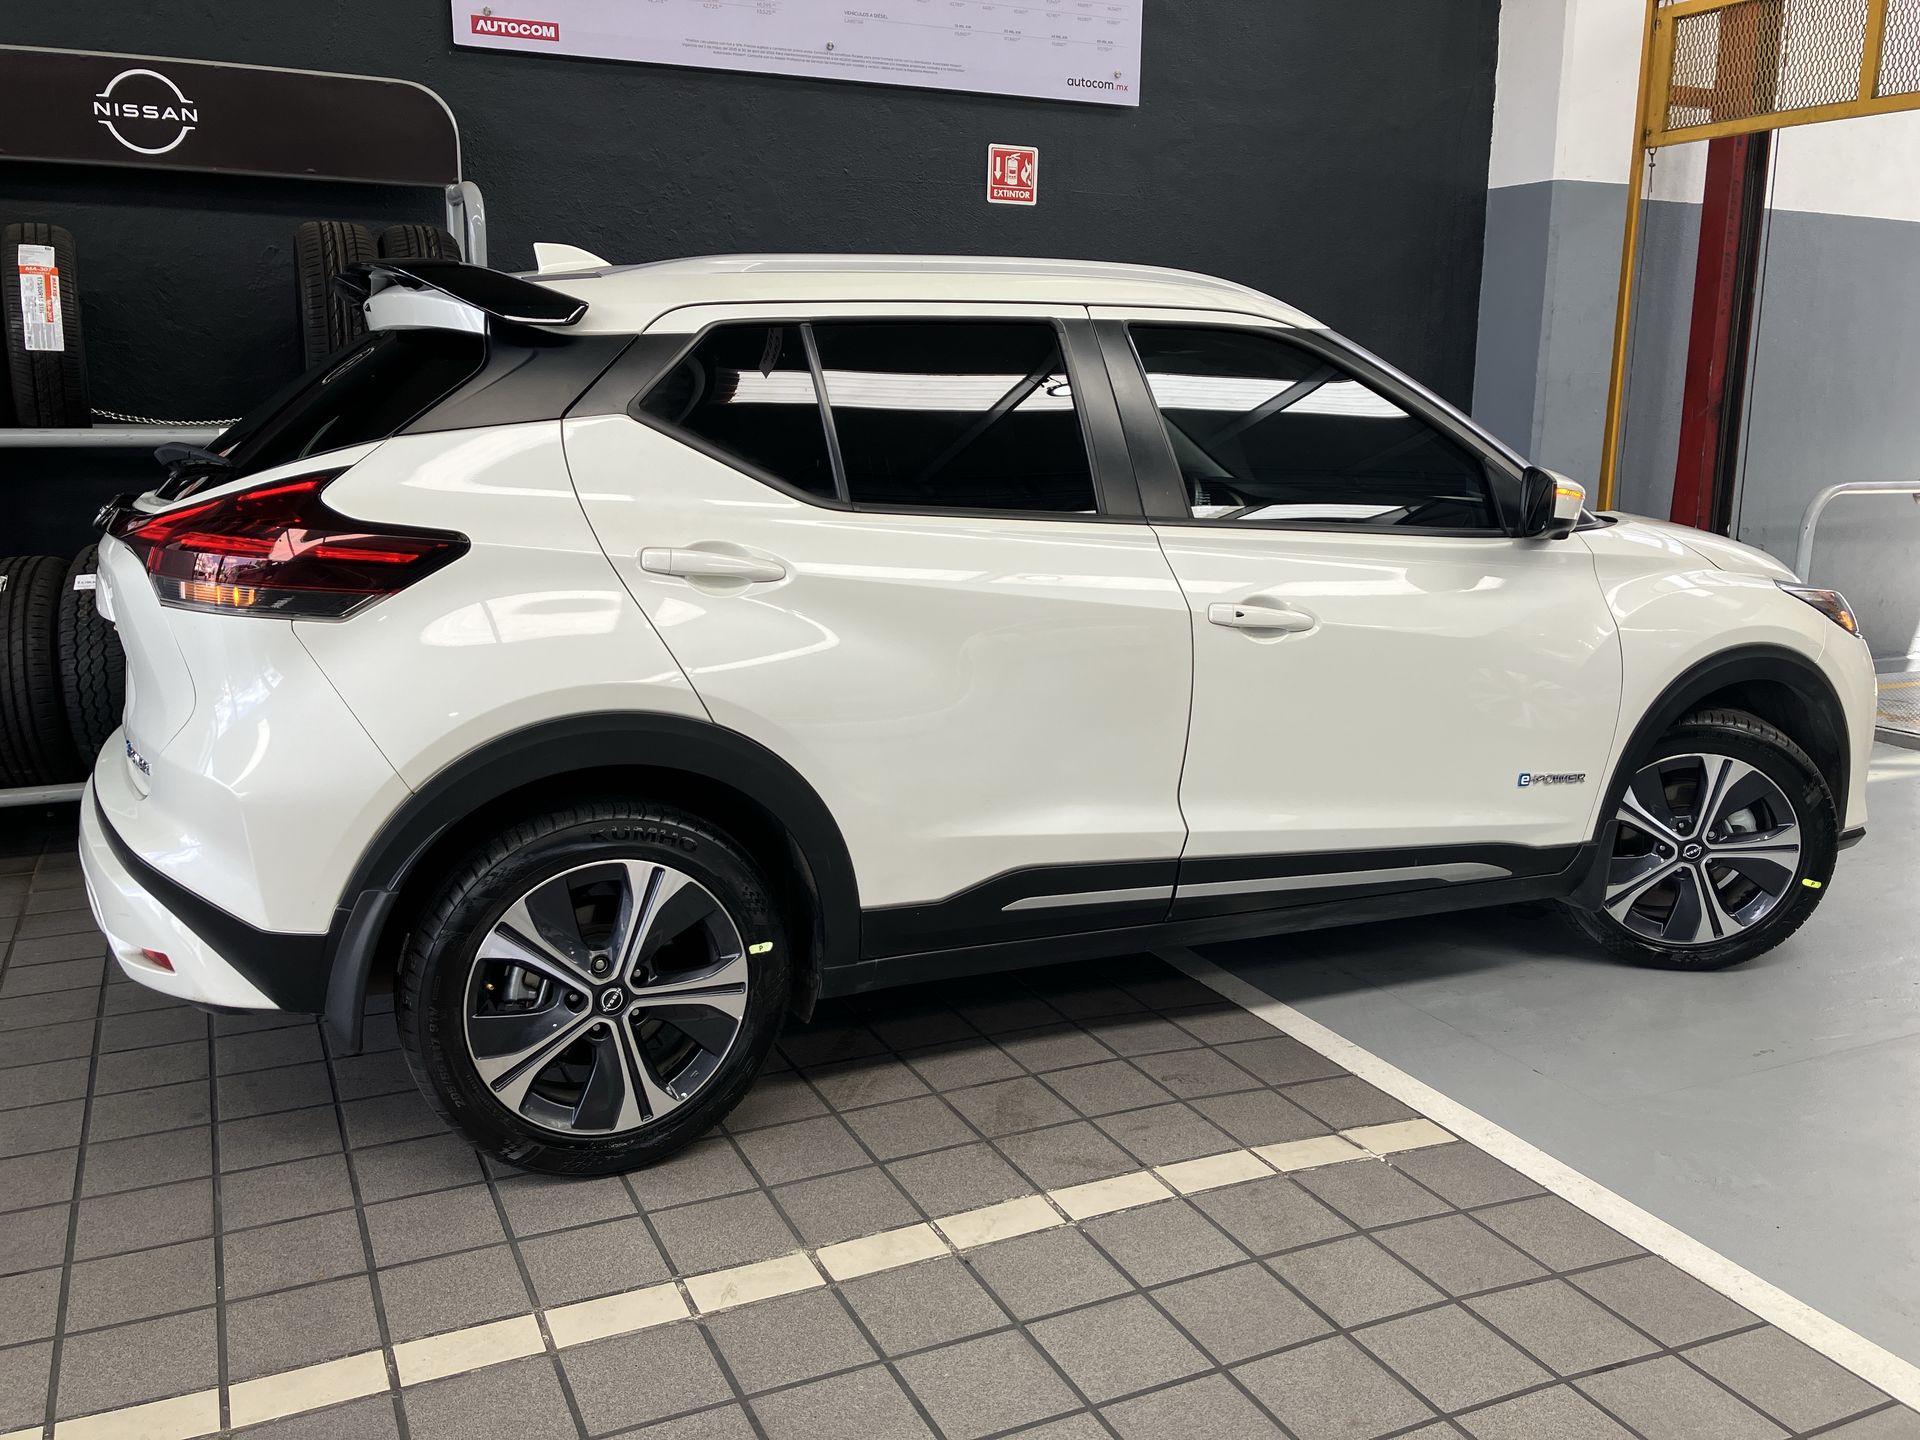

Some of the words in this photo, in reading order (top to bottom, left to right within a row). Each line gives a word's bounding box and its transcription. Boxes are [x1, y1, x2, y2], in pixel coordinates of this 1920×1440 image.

[476, 19, 556, 38] AUTOCOM
[1066, 76, 1129, 92] autocom.mx
[93, 101, 198, 122] NISSAN
[993, 188, 1031, 199] EXTINTOR
[590, 825, 698, 852] KUMHO
